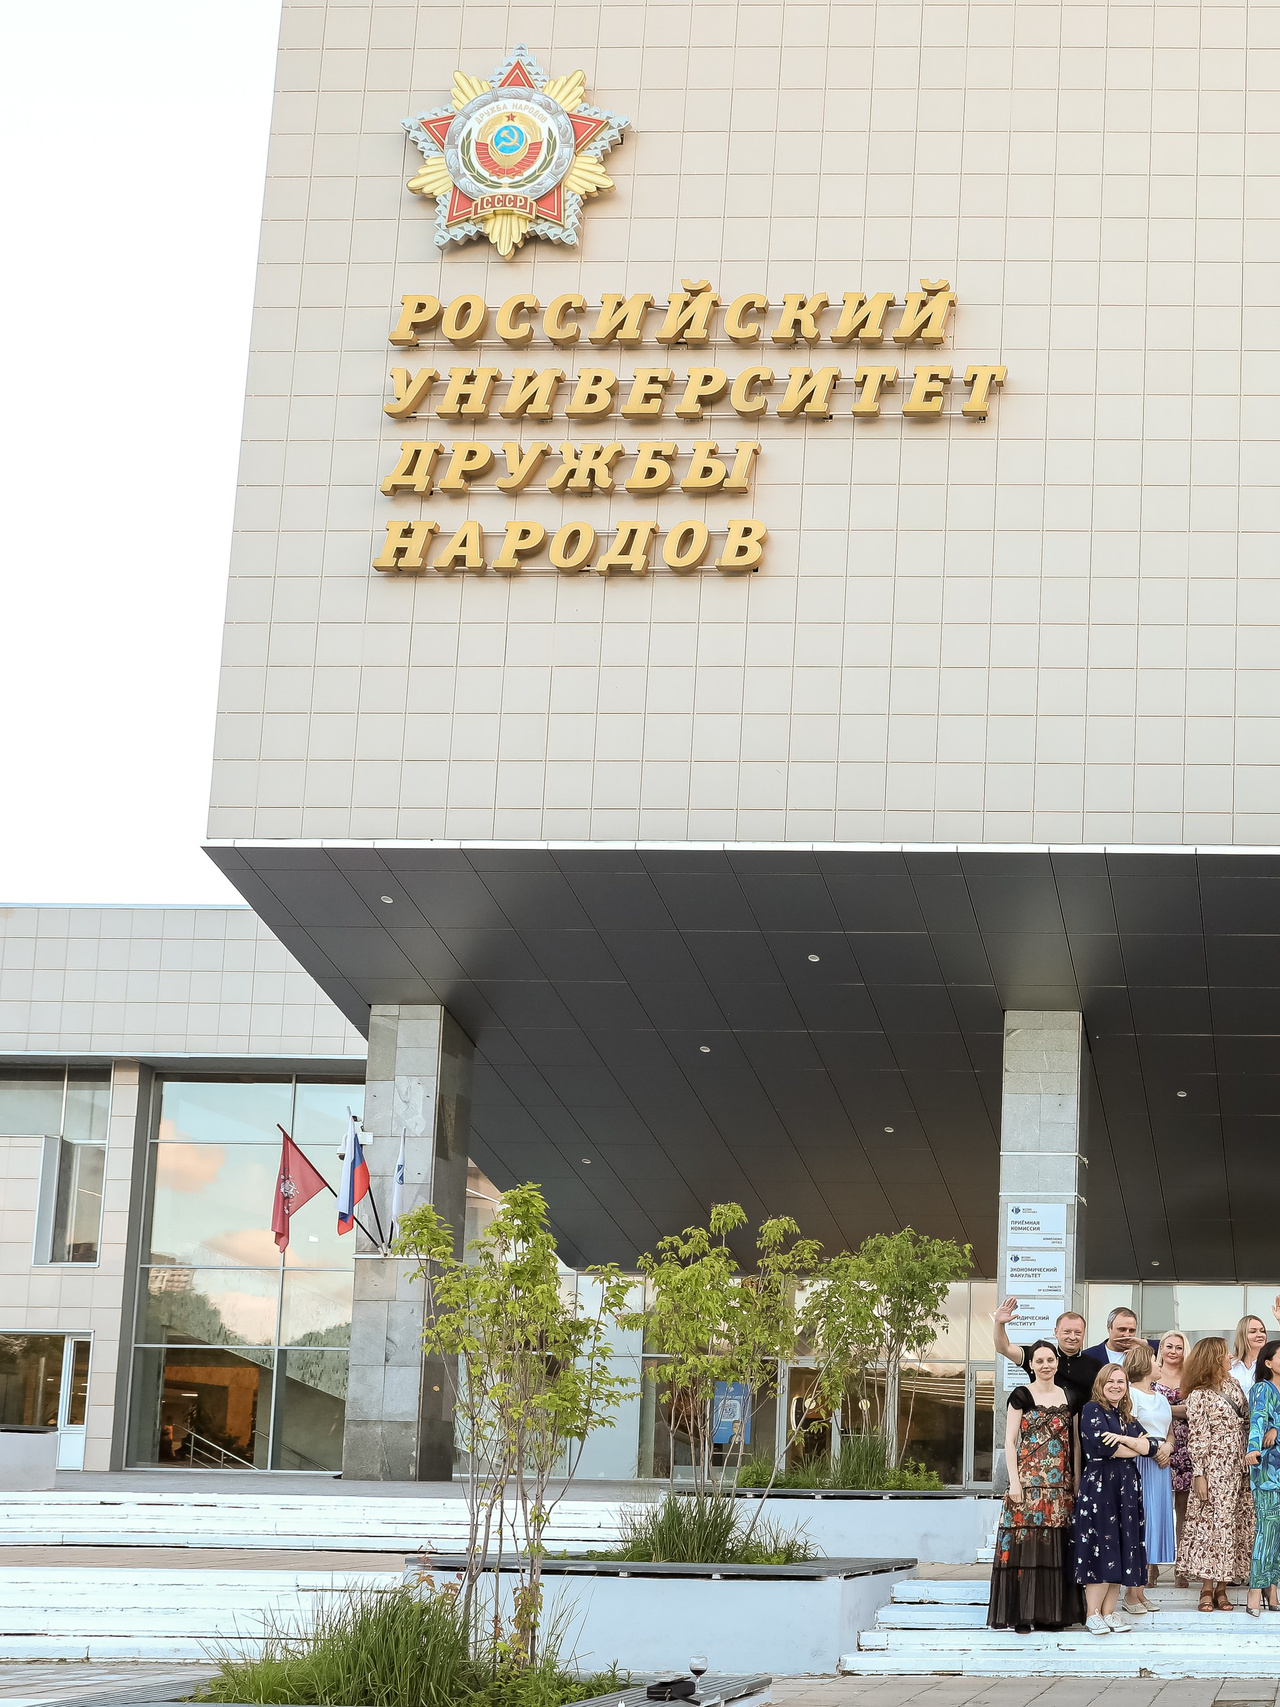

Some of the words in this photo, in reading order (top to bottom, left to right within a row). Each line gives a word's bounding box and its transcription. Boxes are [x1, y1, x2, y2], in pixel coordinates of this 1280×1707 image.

[474, 103, 508, 124] ДРУЖБА
[512, 102, 548, 124] НАРОДОВ
[483, 195, 525, 209] СССР
[388, 279, 959, 347] РОССИЙСКИЙ
[383, 365, 1009, 419] УНИВЕРСИТЕТ
[380, 441, 762, 497] ДРУЖБЫ
[372, 519, 769, 576] НАРОДОВ
